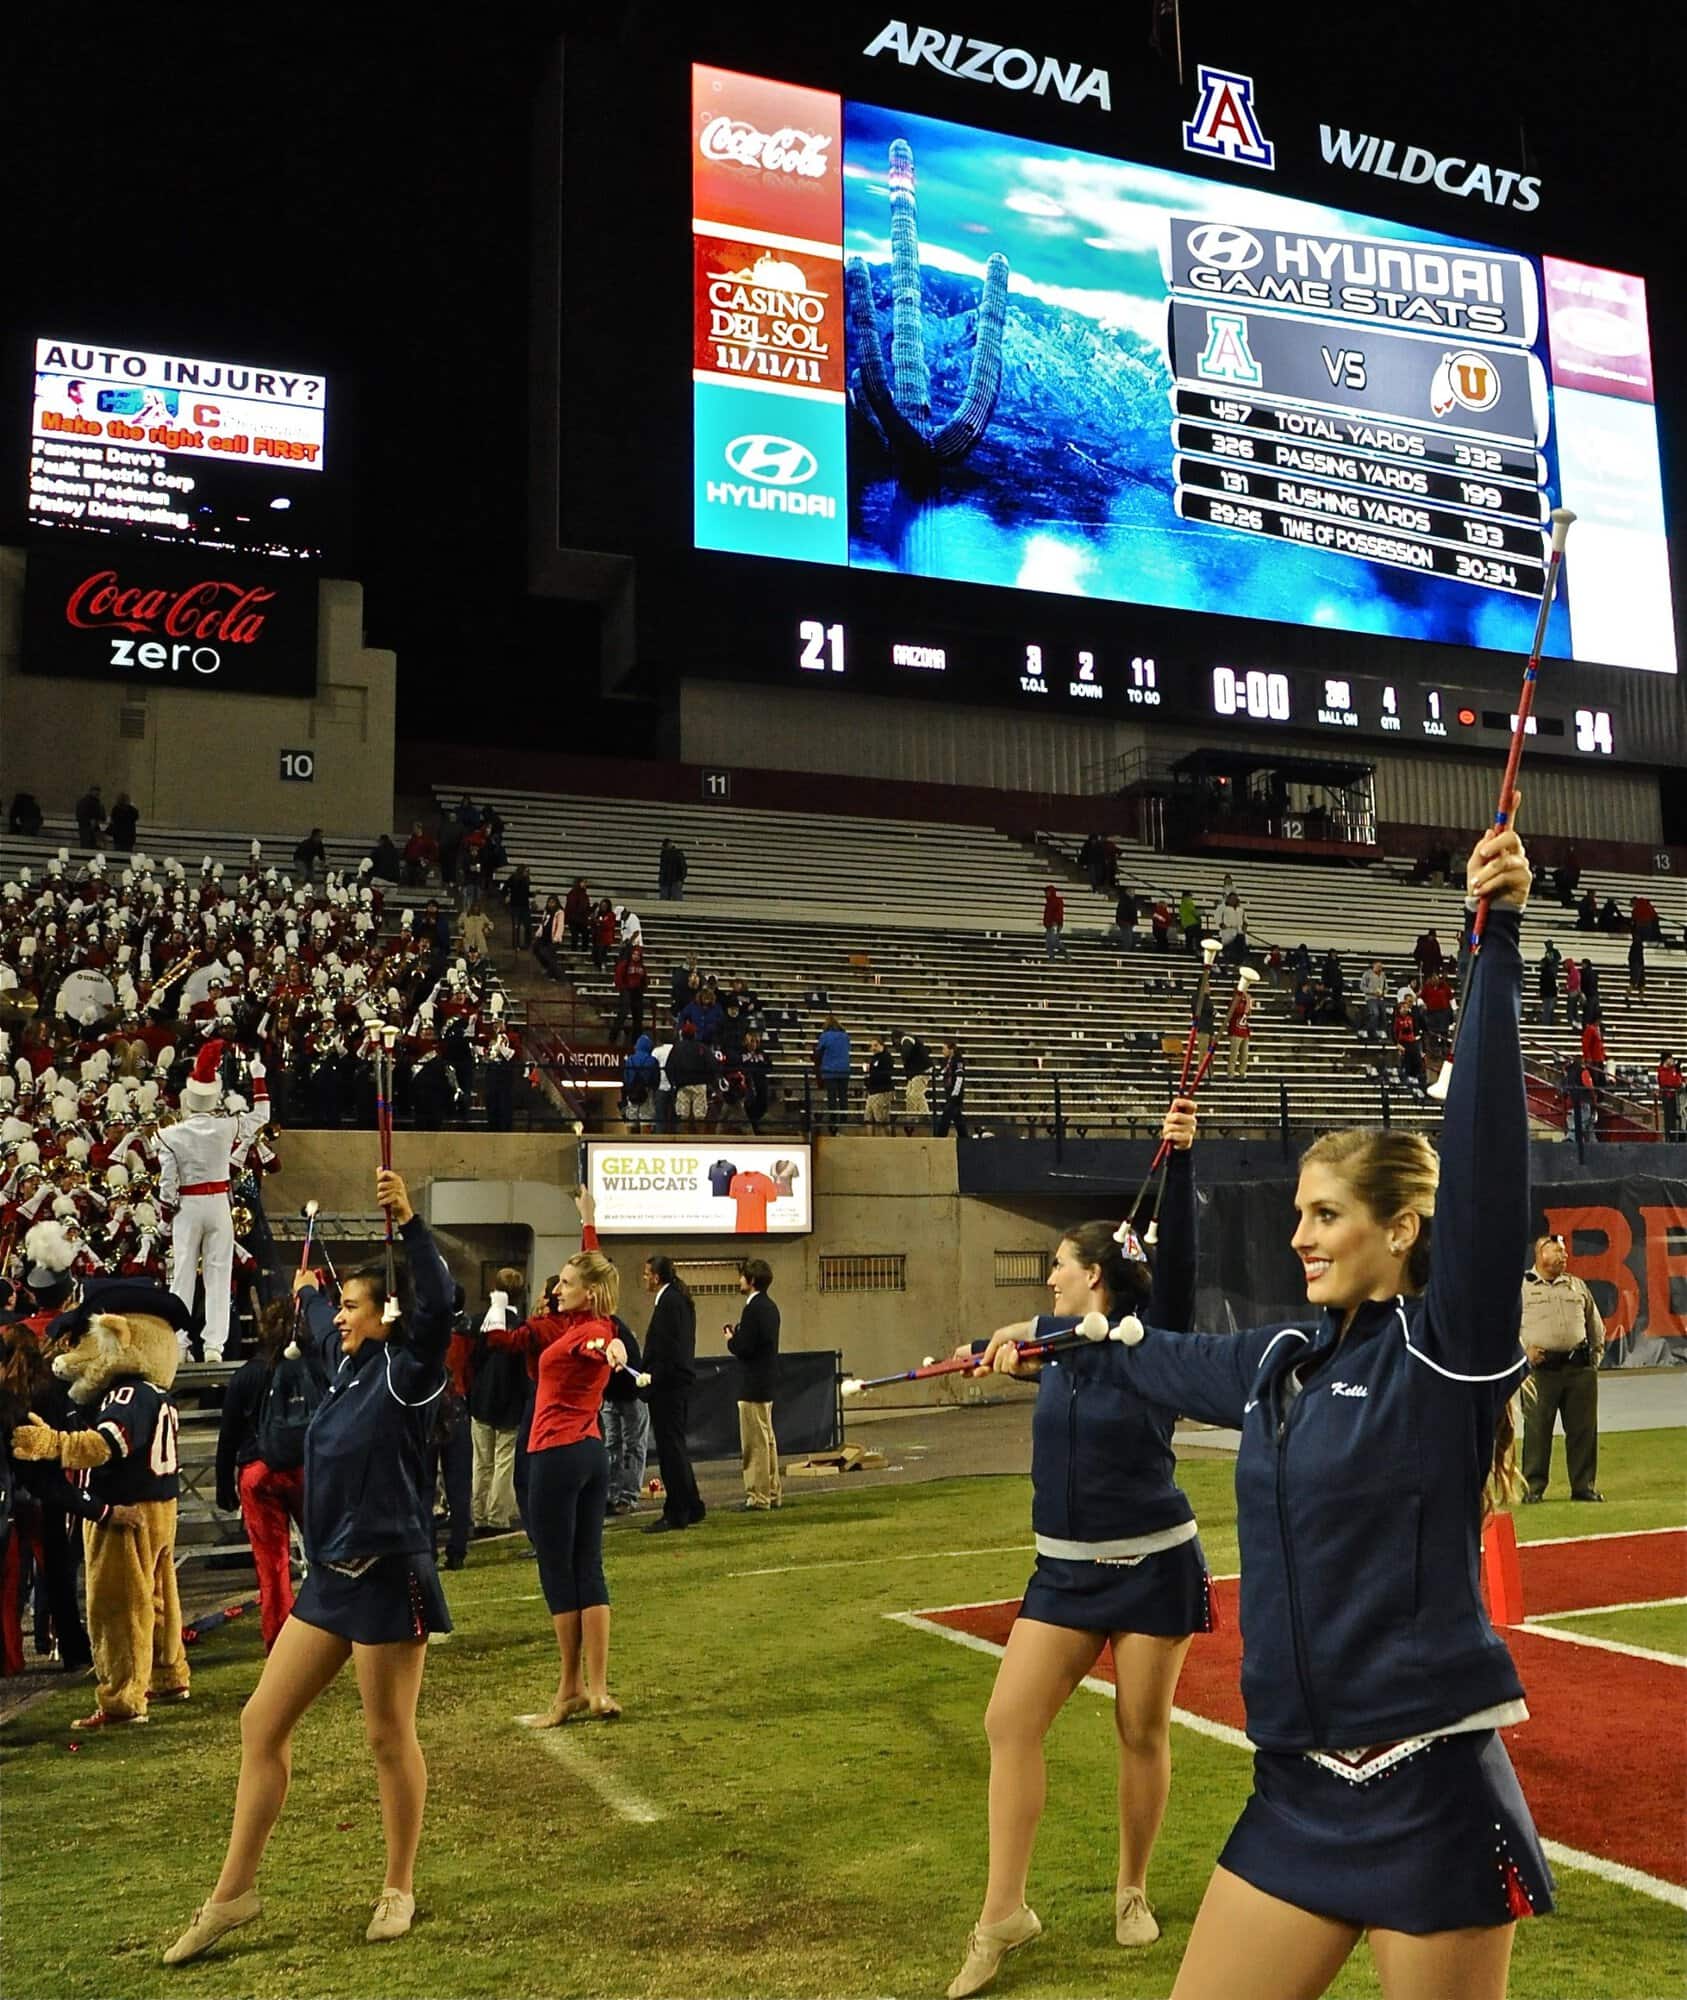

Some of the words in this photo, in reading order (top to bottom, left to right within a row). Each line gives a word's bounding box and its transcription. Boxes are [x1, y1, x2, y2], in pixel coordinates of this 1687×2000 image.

[863, 19, 1112, 111] ARIZONA
[1182, 64, 1275, 170] A
[1319, 124, 1542, 212] WILDCATS
[1276, 236, 1504, 304] HYUNDAI
[709, 281, 825, 324] CASINO
[1190, 266, 1328, 307] GAME
[1341, 287, 1507, 334] STATS
[710, 309, 769, 345] DEL
[772, 320, 828, 354] SOL
[44, 346, 147, 377] AUTO
[163, 361, 320, 400] INJURY?
[716, 345, 821, 383] 11/11/11
[1321, 345, 1367, 391] VS
[32, 439, 103, 461] Famous
[106, 447, 165, 468] Dave's
[42, 411, 102, 436] Make
[107, 420, 144, 441] the
[150, 425, 203, 449] right
[208, 435, 248, 453] call
[253, 436, 320, 461] FIRST
[1210, 400, 1252, 423] 457
[1275, 411, 1343, 441] TOTAL
[1347, 424, 1425, 457] YARDS
[1455, 444, 1502, 471] 332
[152, 471, 194, 493] Corp
[1212, 433, 1254, 459] 326
[1276, 447, 1357, 480] PASSING
[1360, 462, 1428, 494] YARDS
[1460, 483, 1502, 509] 199
[707, 480, 836, 519] HYUNDAI
[1221, 470, 1249, 494] 131
[1278, 482, 1360, 518] RUSHING
[1362, 500, 1431, 532] YARDS
[1464, 520, 1504, 548] 133
[1210, 502, 1263, 530] 29:26
[1280, 516, 1314, 541] TIME
[1314, 524, 1335, 546] OF
[1336, 529, 1434, 569] POSSESSION
[1456, 556, 1517, 588] 30:34
[110, 639, 220, 673] zero
[800, 620, 844, 672] 21
[893, 644, 946, 670] ARIZONA
[1078, 651, 1094, 680] 2
[1131, 657, 1156, 688] 11
[1069, 682, 1103, 699] DOWN
[1127, 689, 1143, 703] TO
[1144, 691, 1161, 705] GO
[1212, 667, 1290, 720] 0:00
[1383, 686, 1396, 714] 4
[1428, 691, 1440, 719] 1
[1318, 709, 1342, 725] BALL
[1343, 712, 1358, 726] ON
[1576, 710, 1612, 754] 34
[281, 754, 313, 777] 10
[706, 774, 727, 795] 11
[1283, 821, 1303, 839] 12
[1653, 854, 1670, 870] 13
[570, 1053, 620, 1067] SECTION
[602, 1157, 667, 1176] GEAR
[671, 1157, 699, 1175] UP
[602, 1177, 698, 1191] WILDCATS
